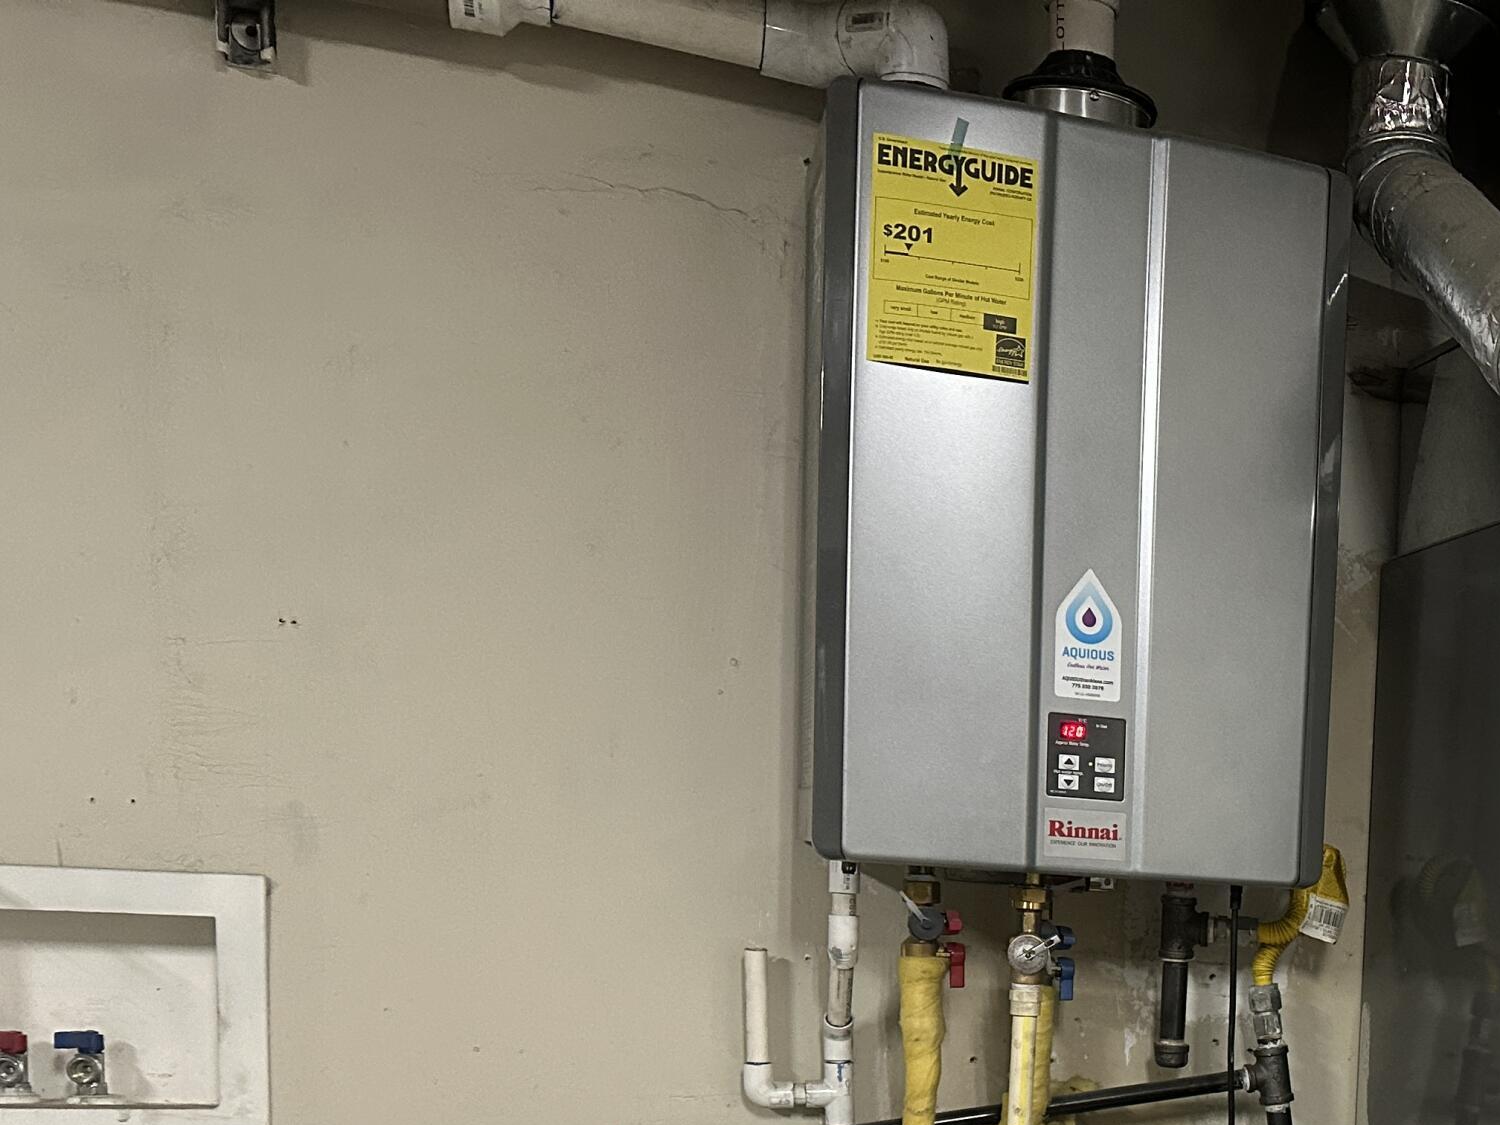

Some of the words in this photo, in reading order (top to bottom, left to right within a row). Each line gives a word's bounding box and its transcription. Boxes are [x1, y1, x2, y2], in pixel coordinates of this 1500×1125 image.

[914, 209, 941, 218] Estimated
[943, 213, 960, 222] Yearly
[961, 216, 980, 224] Energy
[883, 224, 932, 244] $201
[896, 285, 921, 293] Maximum
[1062, 646, 1114, 661] AQUIOUS
[1062, 726, 1084, 738] 120
[1048, 820, 1118, 840] Rinnai
